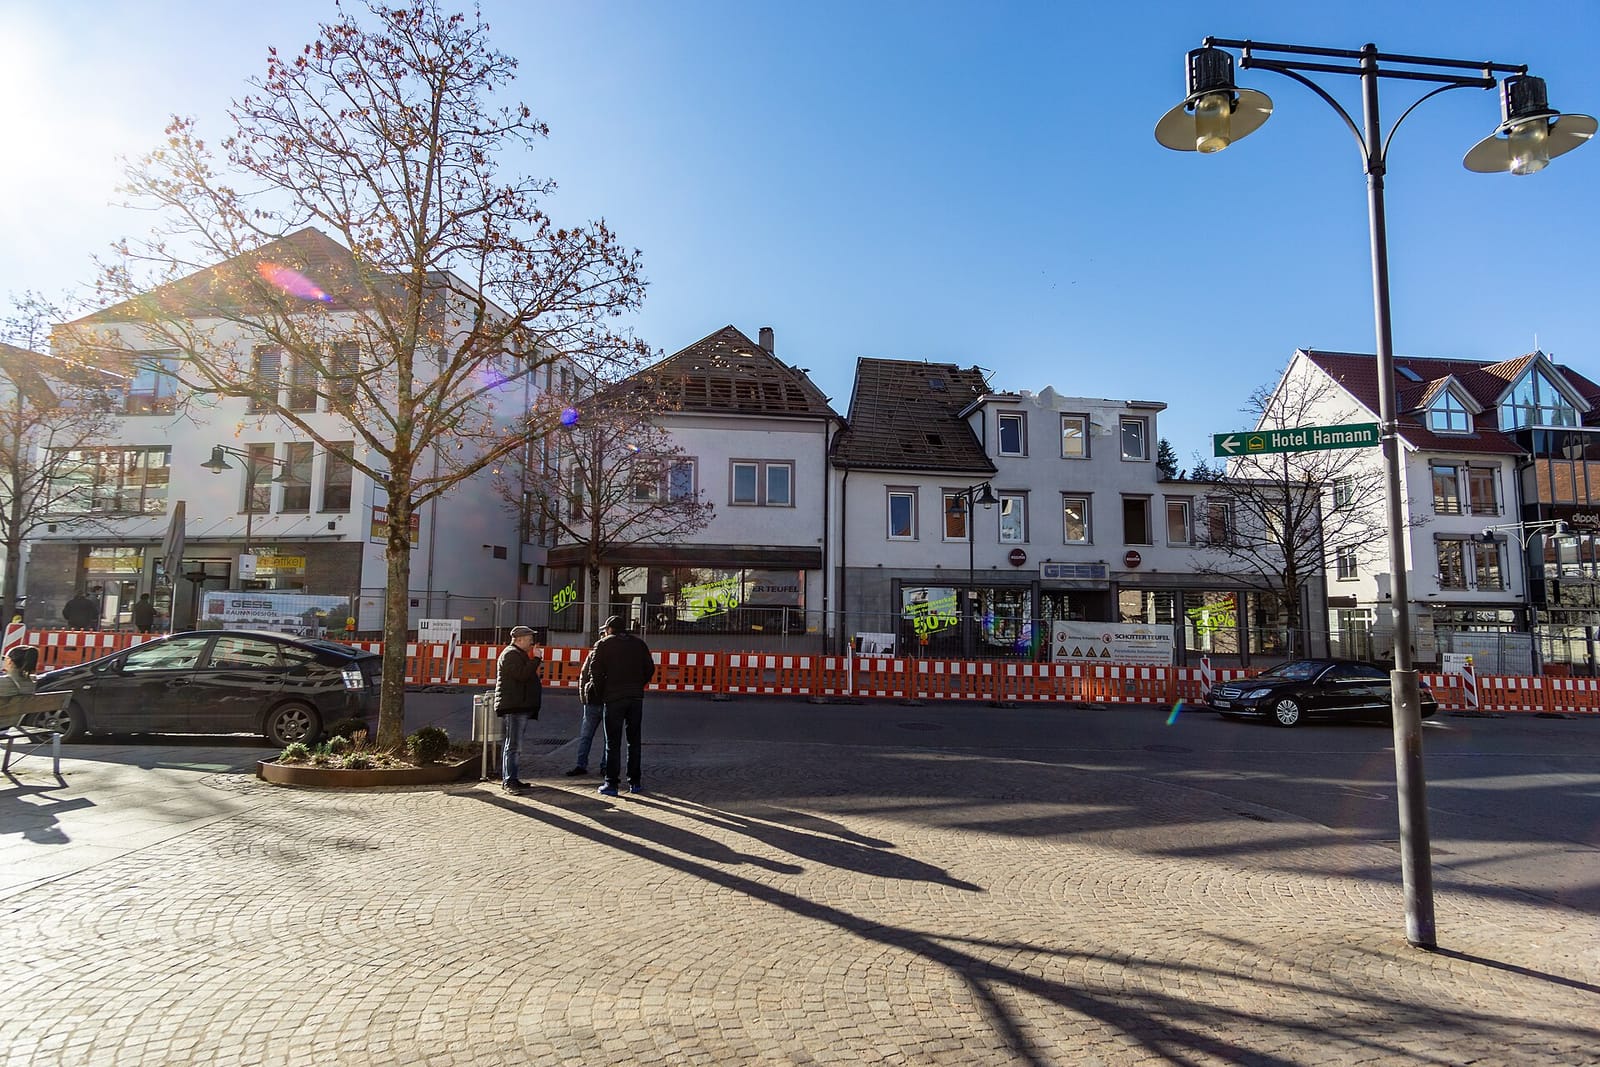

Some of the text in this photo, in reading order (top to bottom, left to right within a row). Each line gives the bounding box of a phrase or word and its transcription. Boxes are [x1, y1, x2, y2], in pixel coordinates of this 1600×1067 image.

[1272, 430, 1371, 447] Hotel Hamann
[1044, 565, 1105, 578] GESS
[231, 600, 273, 609] GESS
[690, 590, 739, 617] 50%
[913, 610, 958, 634] 50%
